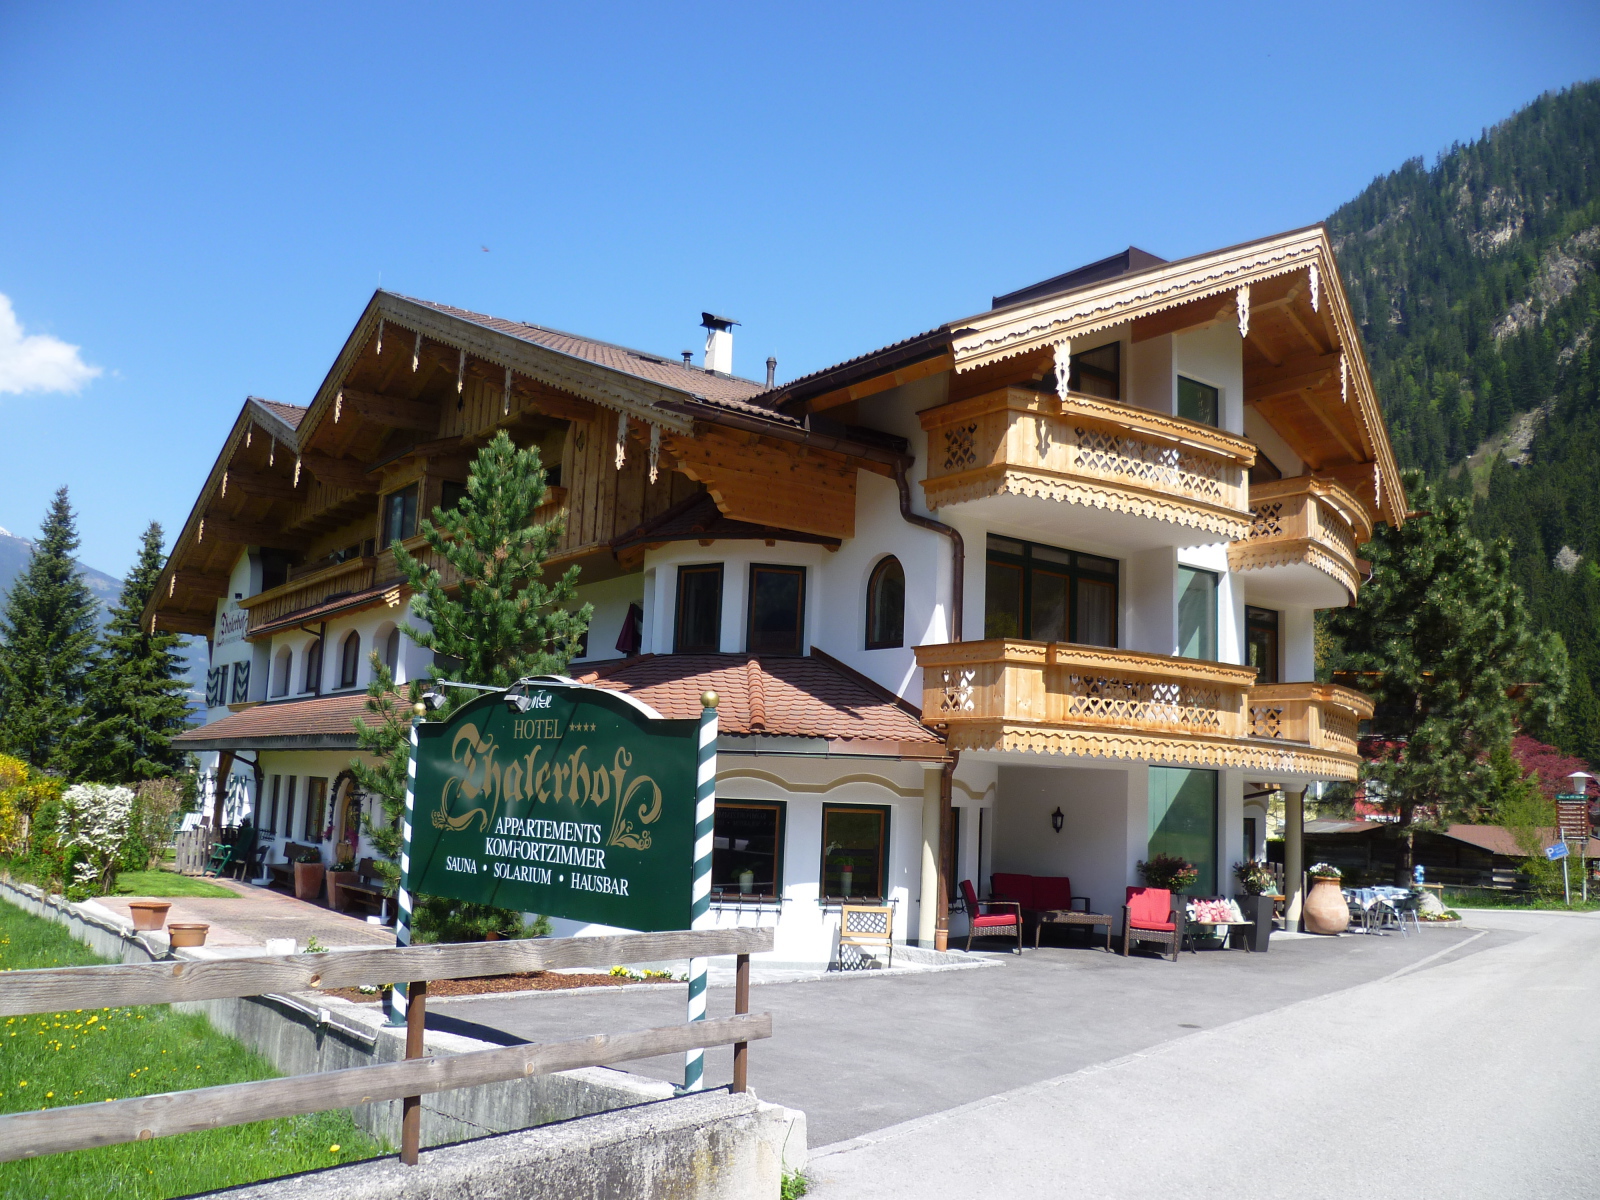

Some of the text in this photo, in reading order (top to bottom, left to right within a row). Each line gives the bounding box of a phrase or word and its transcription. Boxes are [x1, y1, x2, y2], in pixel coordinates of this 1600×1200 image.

[513, 719, 563, 739] HOTEL
[442, 722, 640, 832] Thalerhof
[494, 816, 602, 844] APPARTEMENTS
[485, 837, 606, 869] KOMFORTZIMMER
[1546, 848, 1554, 857] P
[445, 856, 629, 896] SAUNA SOLARIUM HAUSBAR
